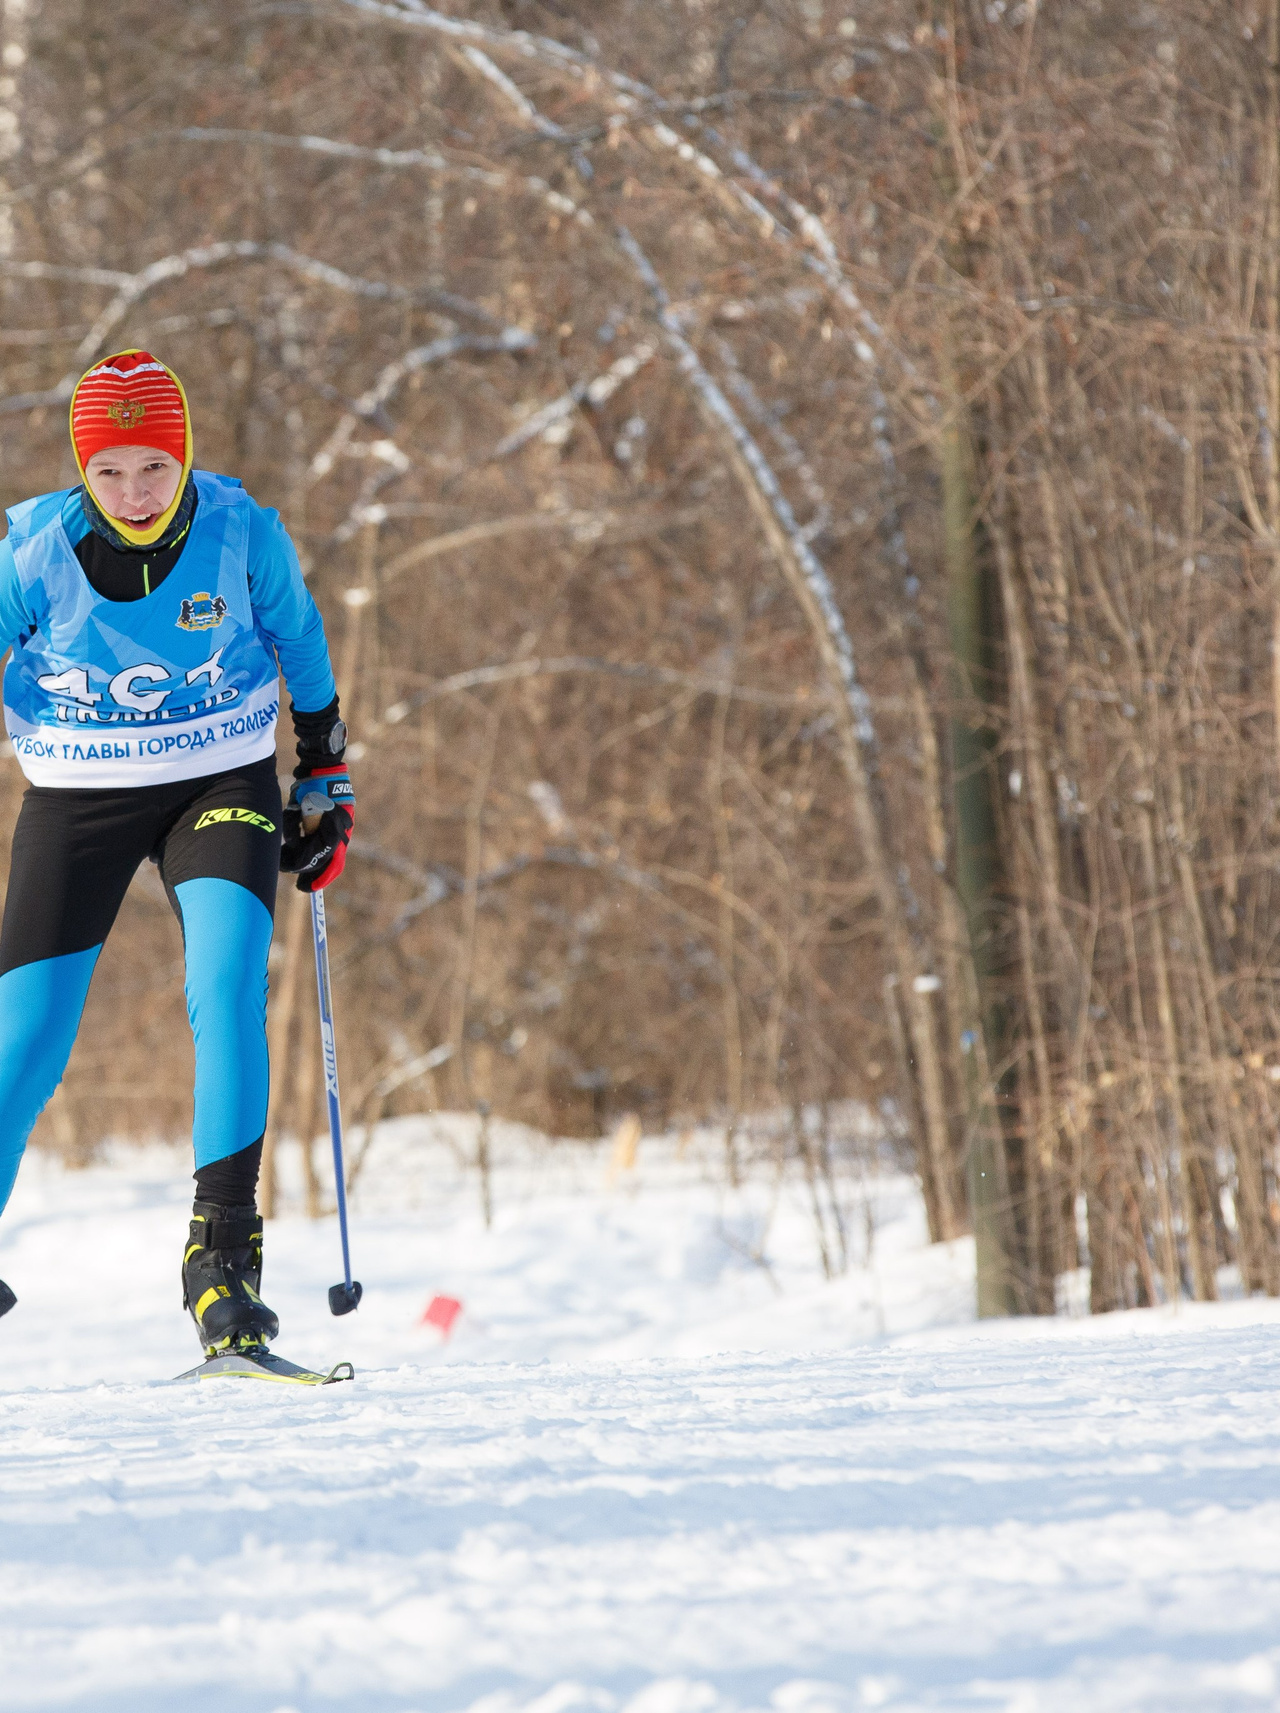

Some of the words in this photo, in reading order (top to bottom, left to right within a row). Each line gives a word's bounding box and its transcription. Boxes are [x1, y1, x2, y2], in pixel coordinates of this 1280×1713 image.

[10, 732, 58, 760] УБОК
[62, 741, 131, 760] ГЛАВЫ
[138, 727, 217, 757] ГОРОДА
[220, 699, 280, 739] ТЮМЕН
